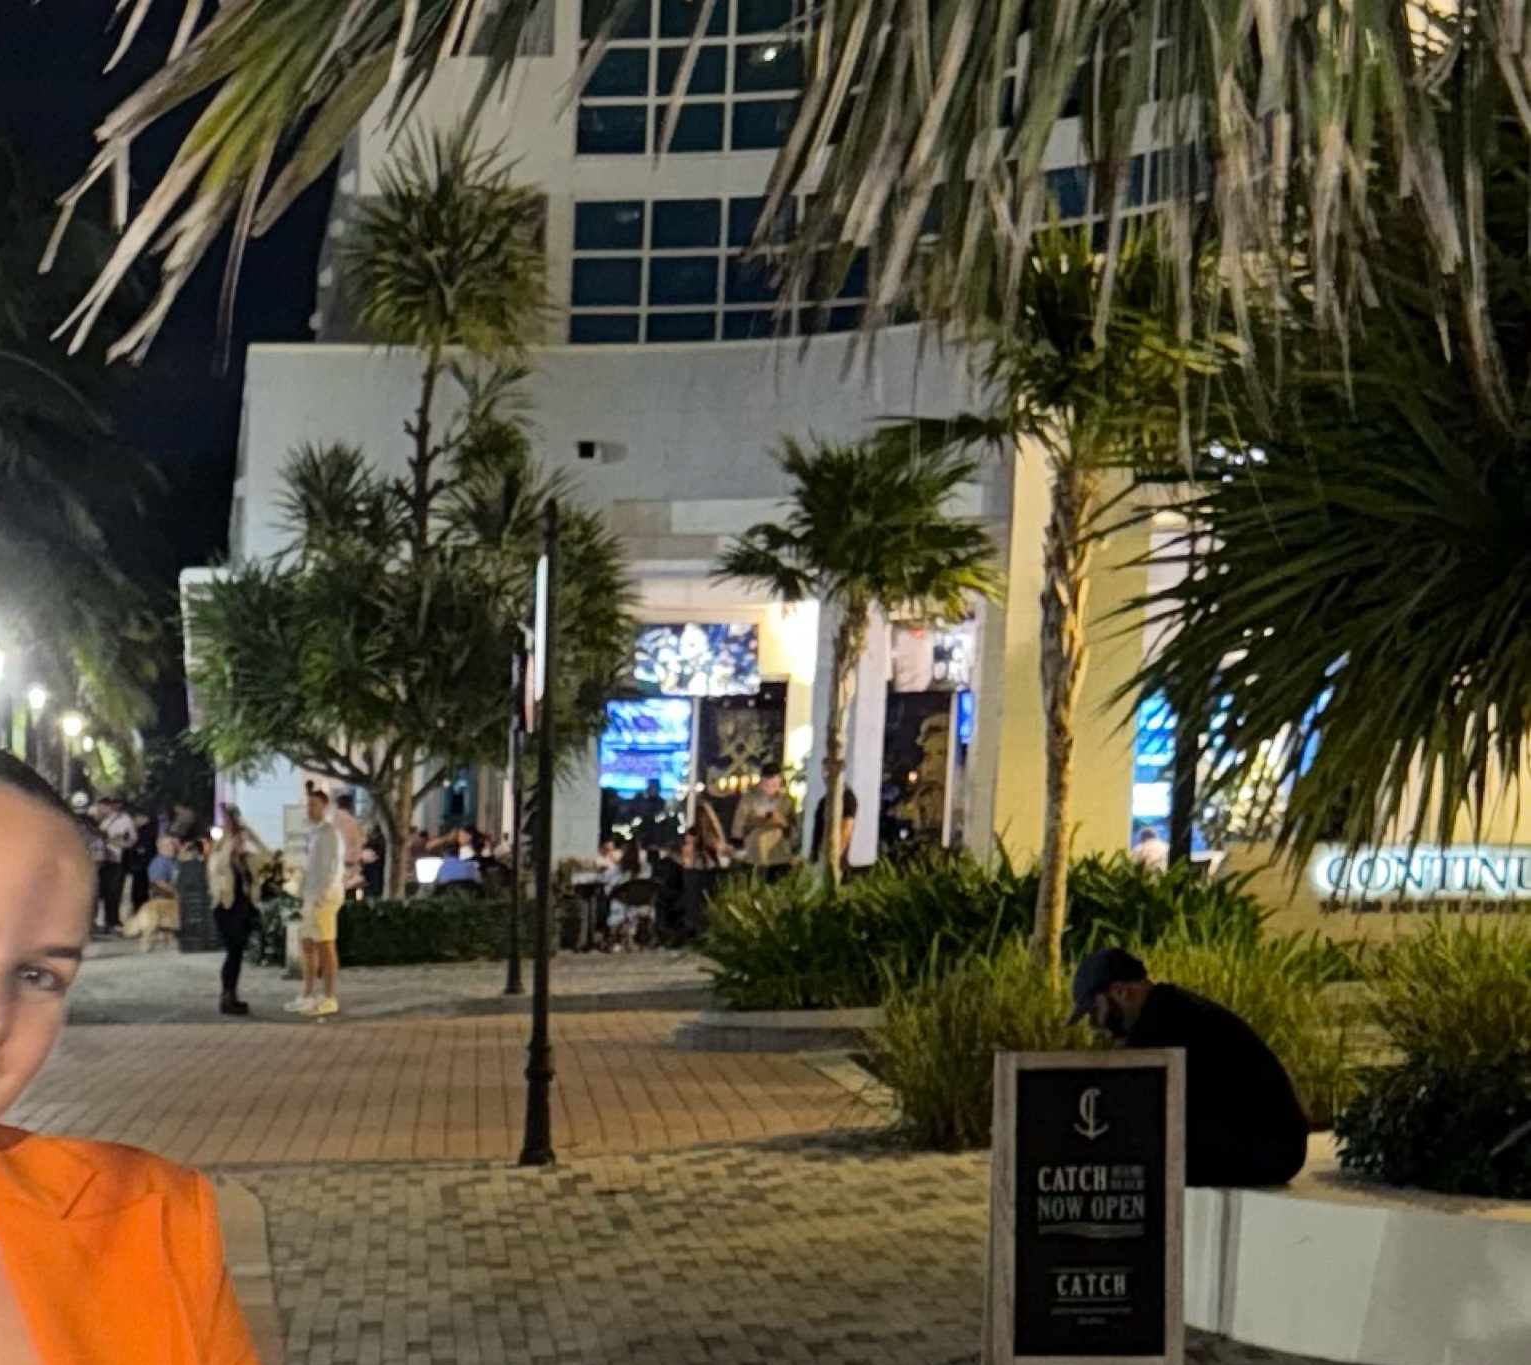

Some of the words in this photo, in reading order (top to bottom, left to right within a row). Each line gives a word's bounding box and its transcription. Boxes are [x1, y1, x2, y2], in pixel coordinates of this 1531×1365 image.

[1037, 1165, 1108, 1192] CATCH
[1037, 1194, 1084, 1222] NOW
[1090, 1194, 1146, 1222] OPEN
[1056, 1273, 1127, 1297] CATCH
